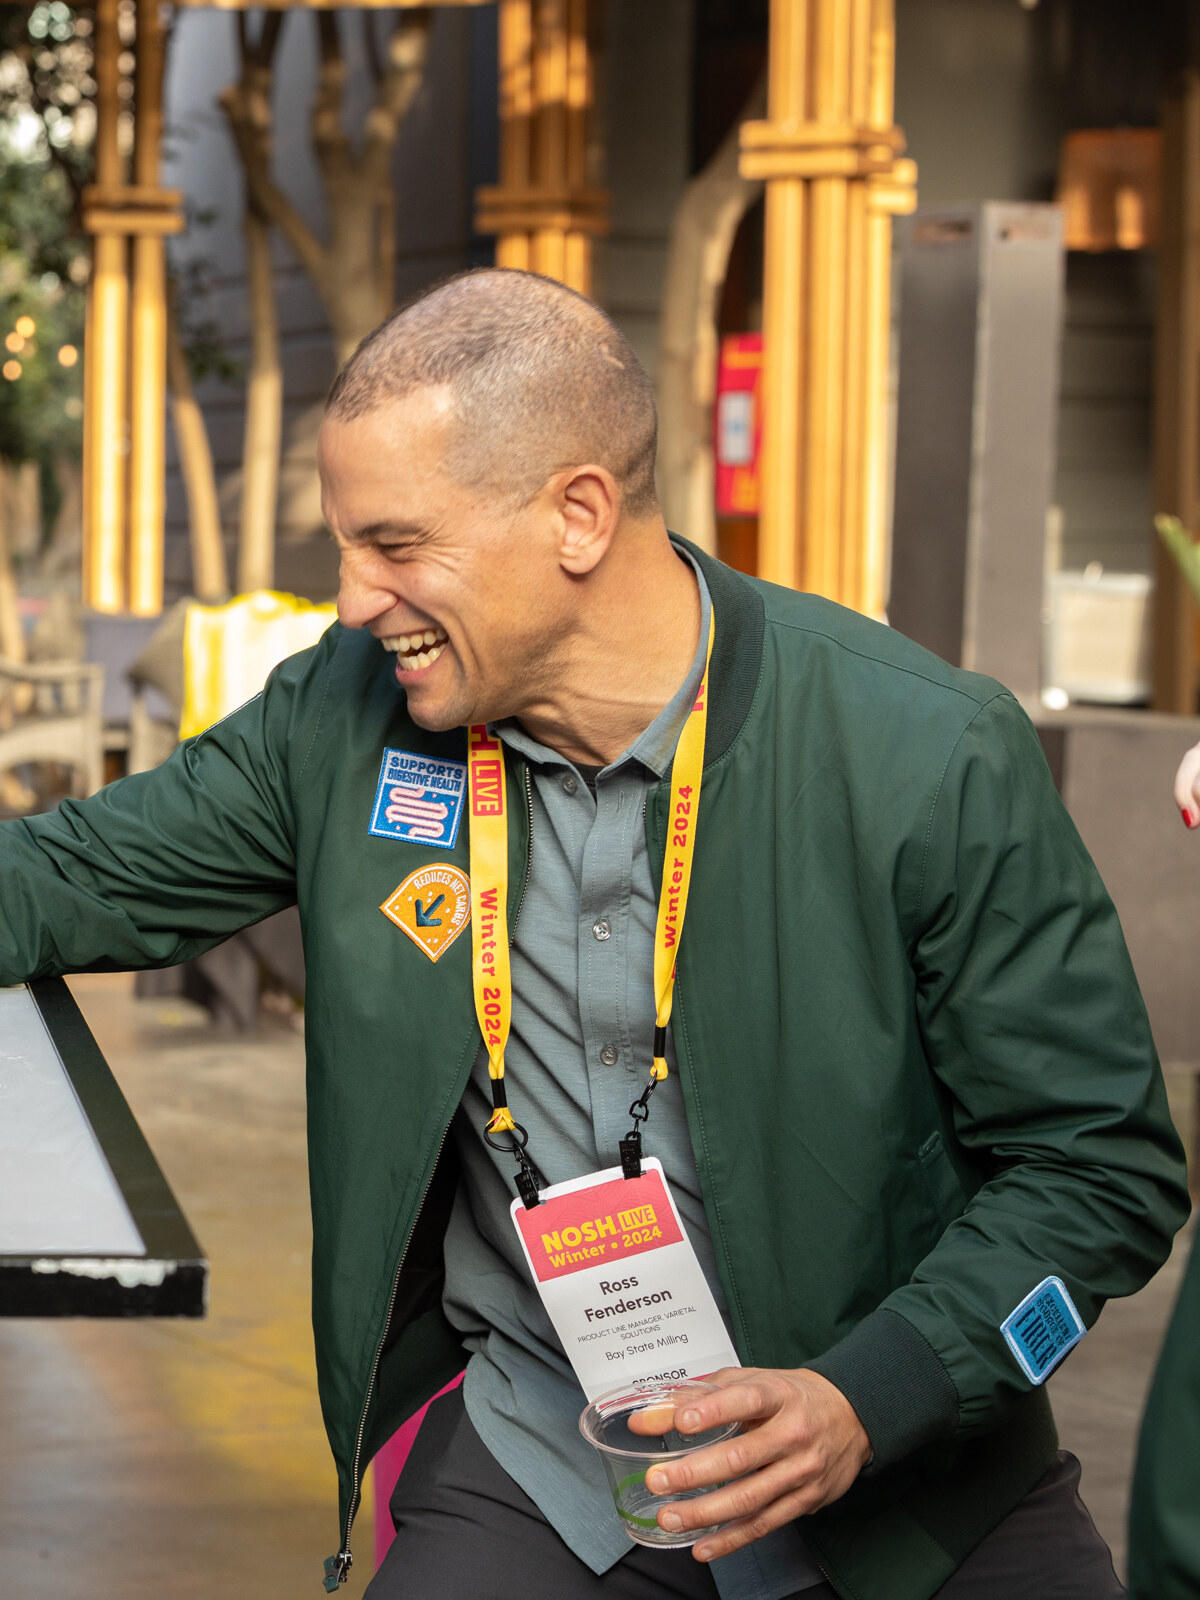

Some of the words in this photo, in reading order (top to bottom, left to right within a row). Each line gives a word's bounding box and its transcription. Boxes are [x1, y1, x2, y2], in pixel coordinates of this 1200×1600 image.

[387, 767, 431, 787] DIGESTIVE
[430, 775, 461, 793] HEALTH
[389, 756, 463, 780] SUPPORTS
[475, 764, 500, 813] LIVE
[673, 785, 693, 848] 2024
[413, 871, 453, 890] REDUCES
[449, 878, 466, 896] NET
[451, 894, 468, 926] CARBS
[664, 857, 684, 949] Winter
[480, 888, 499, 977] Winter
[482, 988, 502, 1048] 2024
[541, 1215, 617, 1254] NOSH
[621, 1207, 655, 1230] LIVE
[549, 1244, 606, 1268] Winter
[622, 1225, 662, 1248] 2024
[599, 1276, 639, 1296] Ross
[577, 1328, 611, 1343] PRODUCT
[611, 1324, 627, 1334] LINE
[664, 1306, 697, 1320] VARIETAL
[584, 1290, 673, 1323] Fenderson
[1036, 1298, 1059, 1335] SOURCE
[1056, 1335, 1065, 1347] OF
[1043, 1292, 1071, 1340] EXCELLENT
[605, 1350, 625, 1361] Bay
[626, 1343, 655, 1355] State
[656, 1333, 689, 1348] Milling
[620, 1324, 661, 1340] SOLUTIONS
[1015, 1306, 1057, 1370] FIBER
